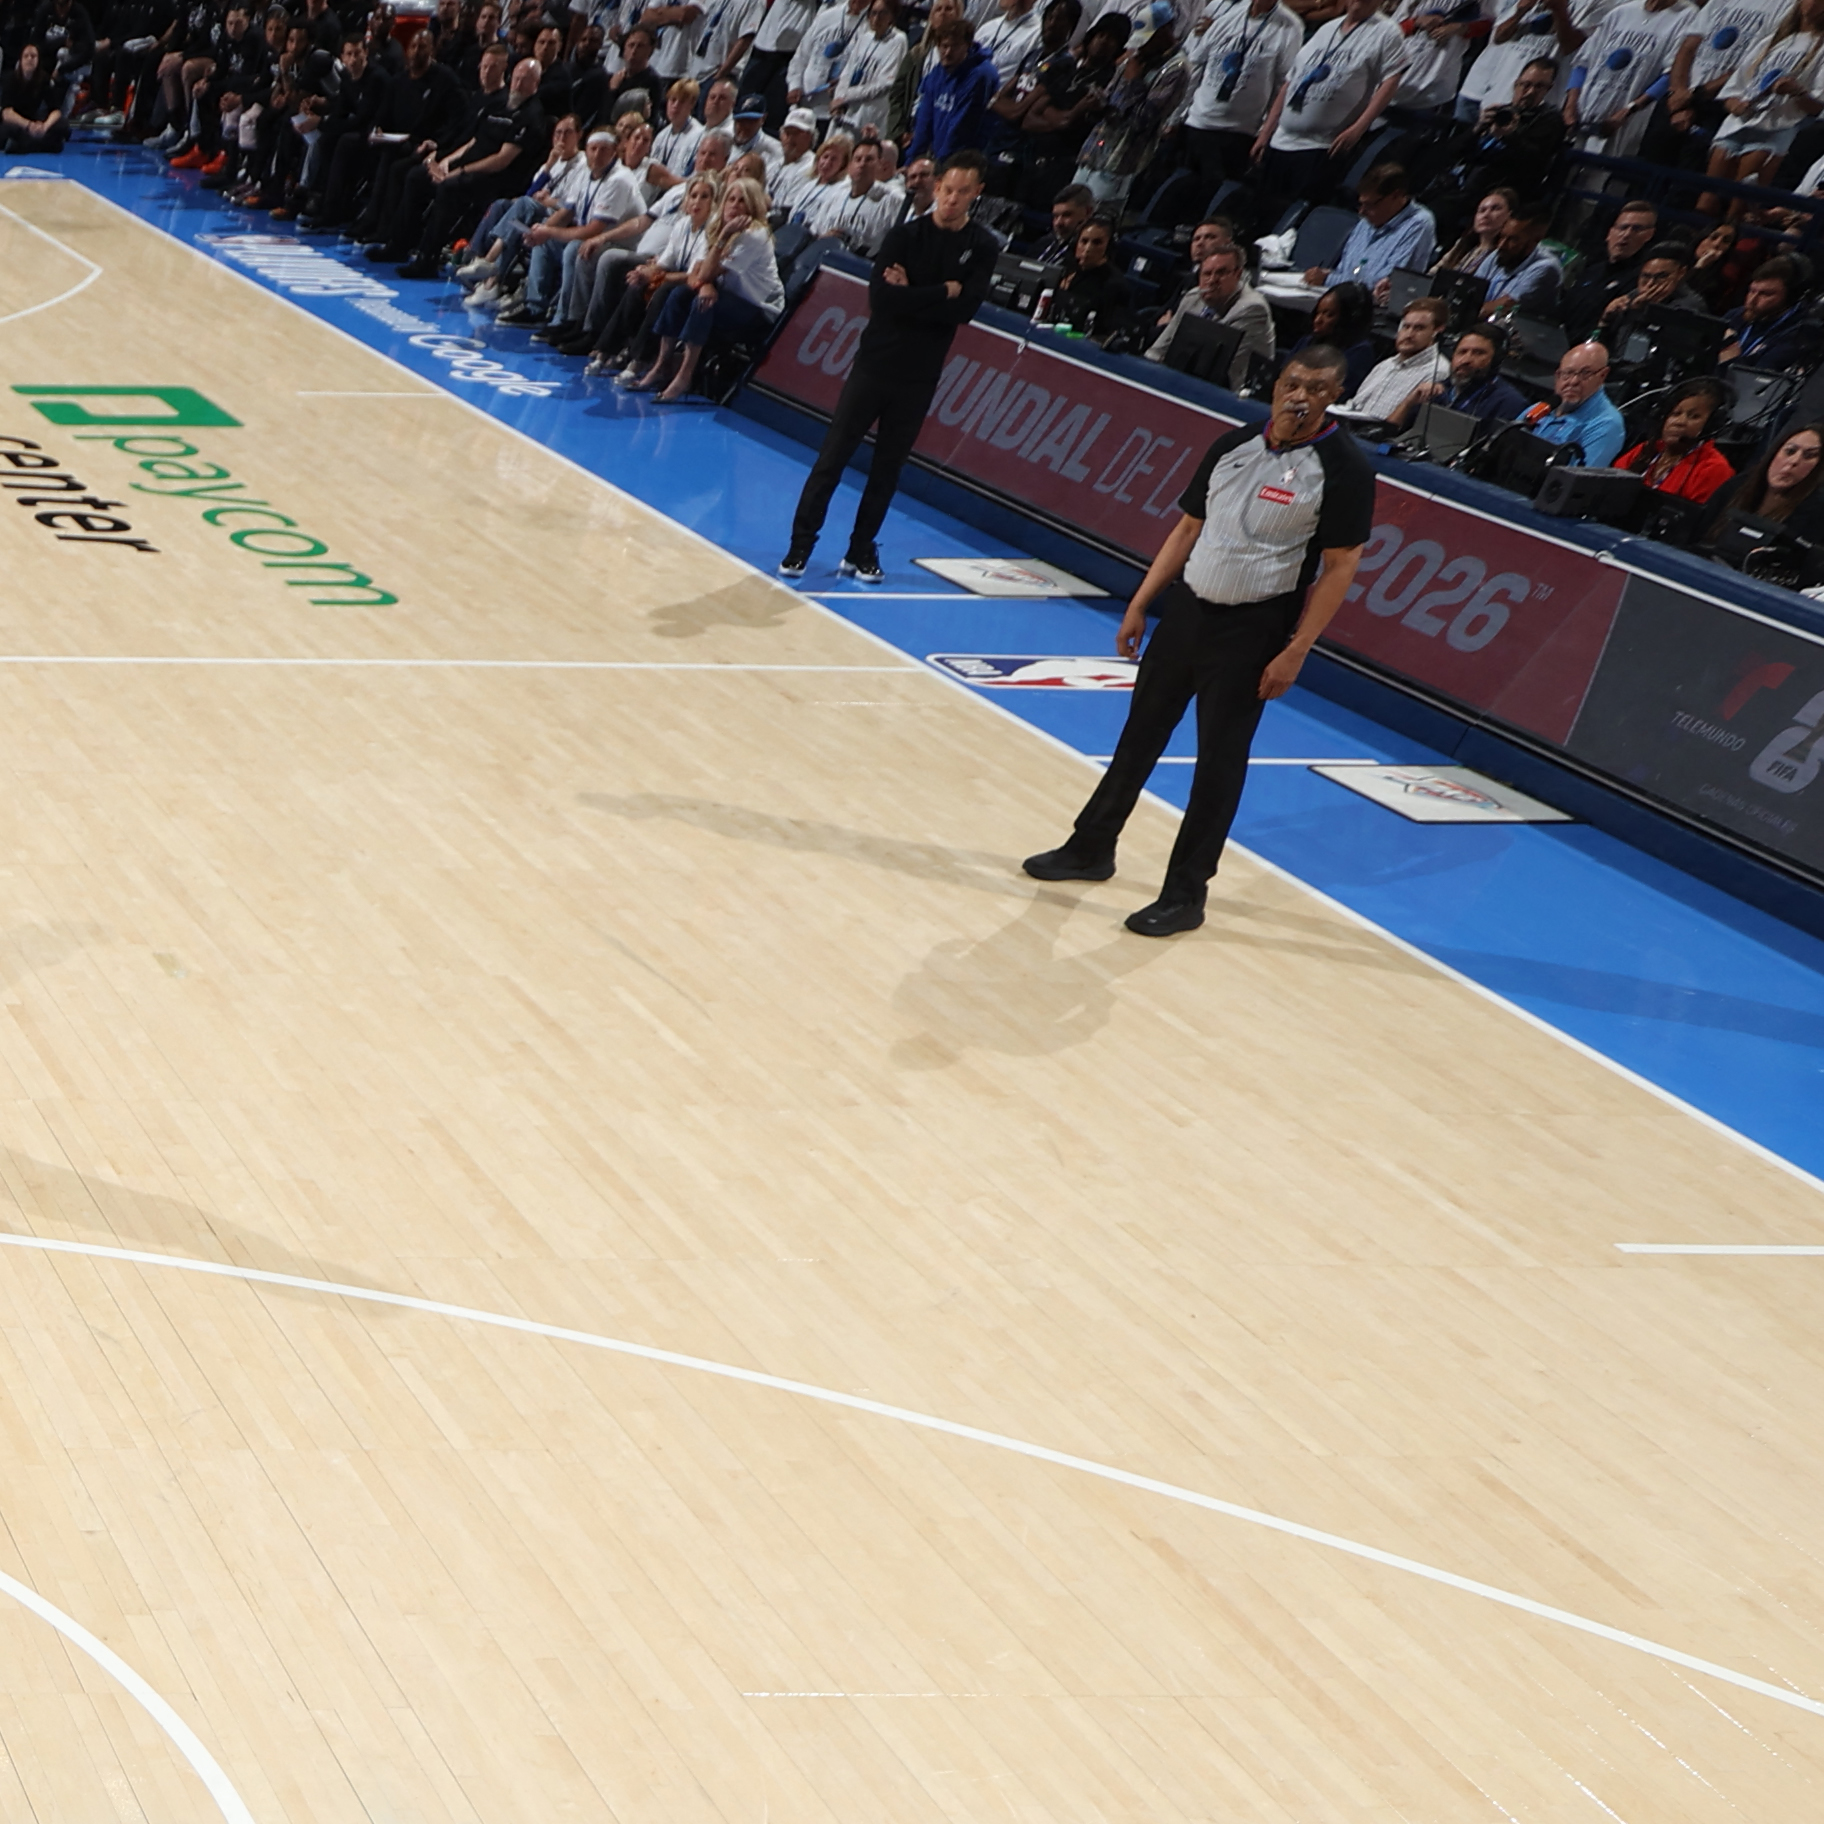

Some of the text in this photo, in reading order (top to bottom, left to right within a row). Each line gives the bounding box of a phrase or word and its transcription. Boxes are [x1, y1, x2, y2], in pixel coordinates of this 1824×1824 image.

[408, 334, 563, 397] Google
[1102, 429, 1175, 501] DE
[73, 435, 399, 605] paycom
[1671, 710, 1747, 751] TELEMUNDO
[1766, 759, 1798, 783] FIFA
